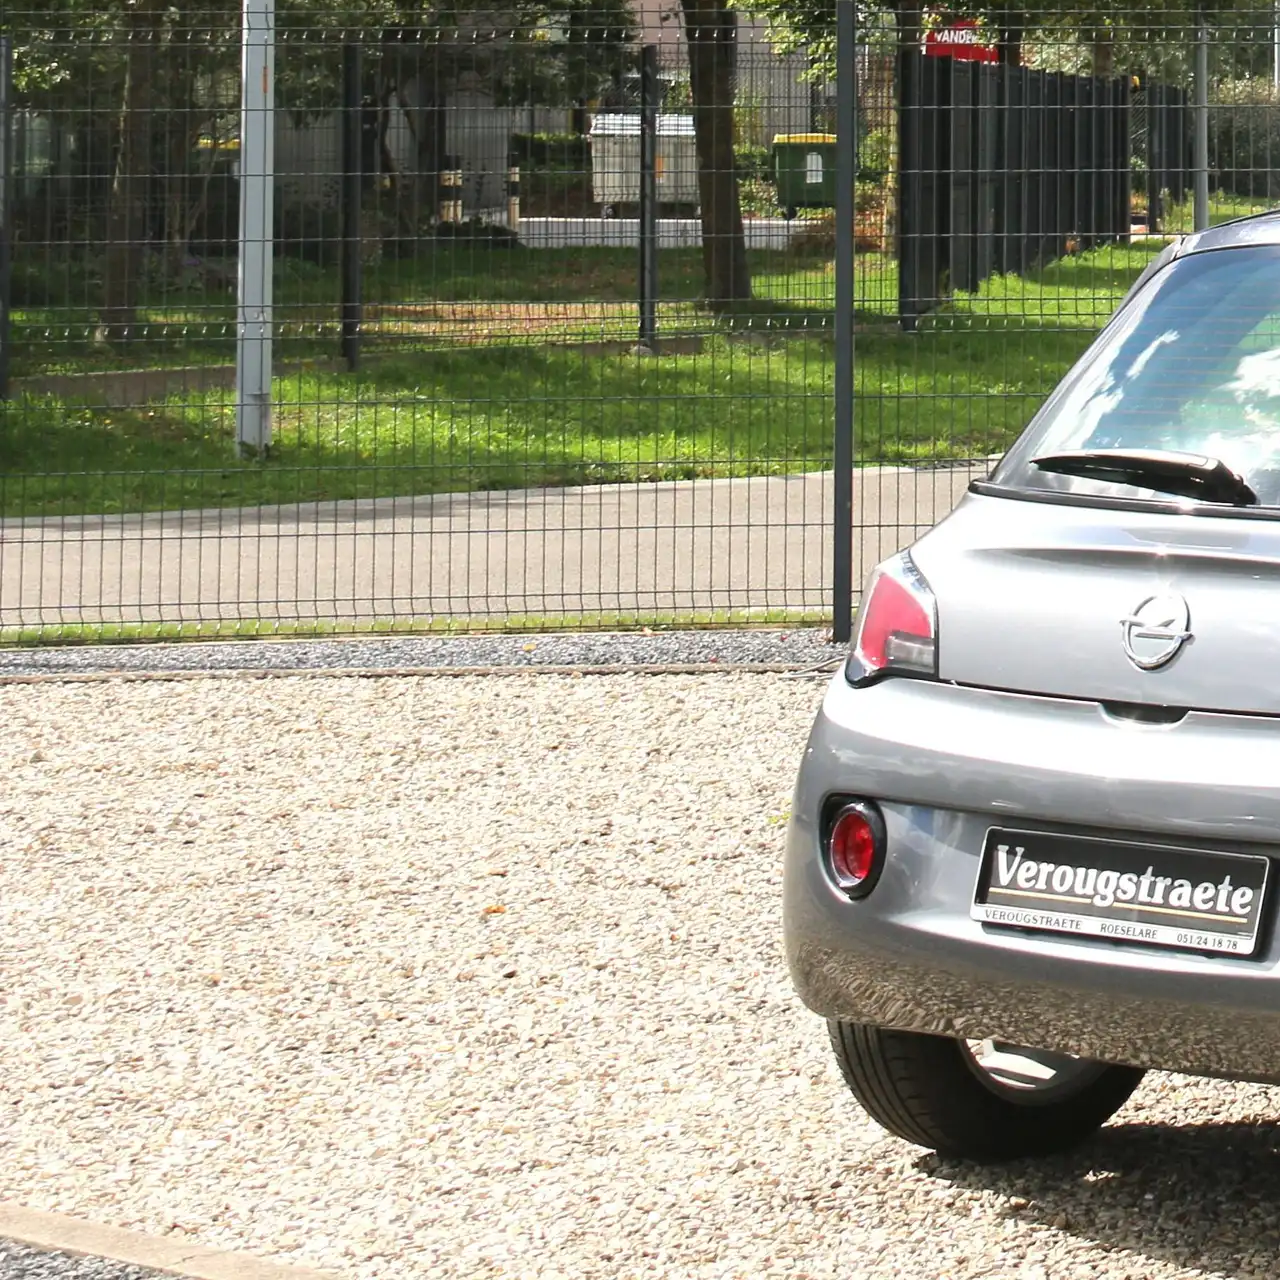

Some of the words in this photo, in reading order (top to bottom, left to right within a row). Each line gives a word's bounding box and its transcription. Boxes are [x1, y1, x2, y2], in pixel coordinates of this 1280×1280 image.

[996, 844, 1255, 915] Verougstraete
[985, 908, 1084, 930] VEROUGSTRAETE
[1099, 923, 1158, 940] ROESELARE
